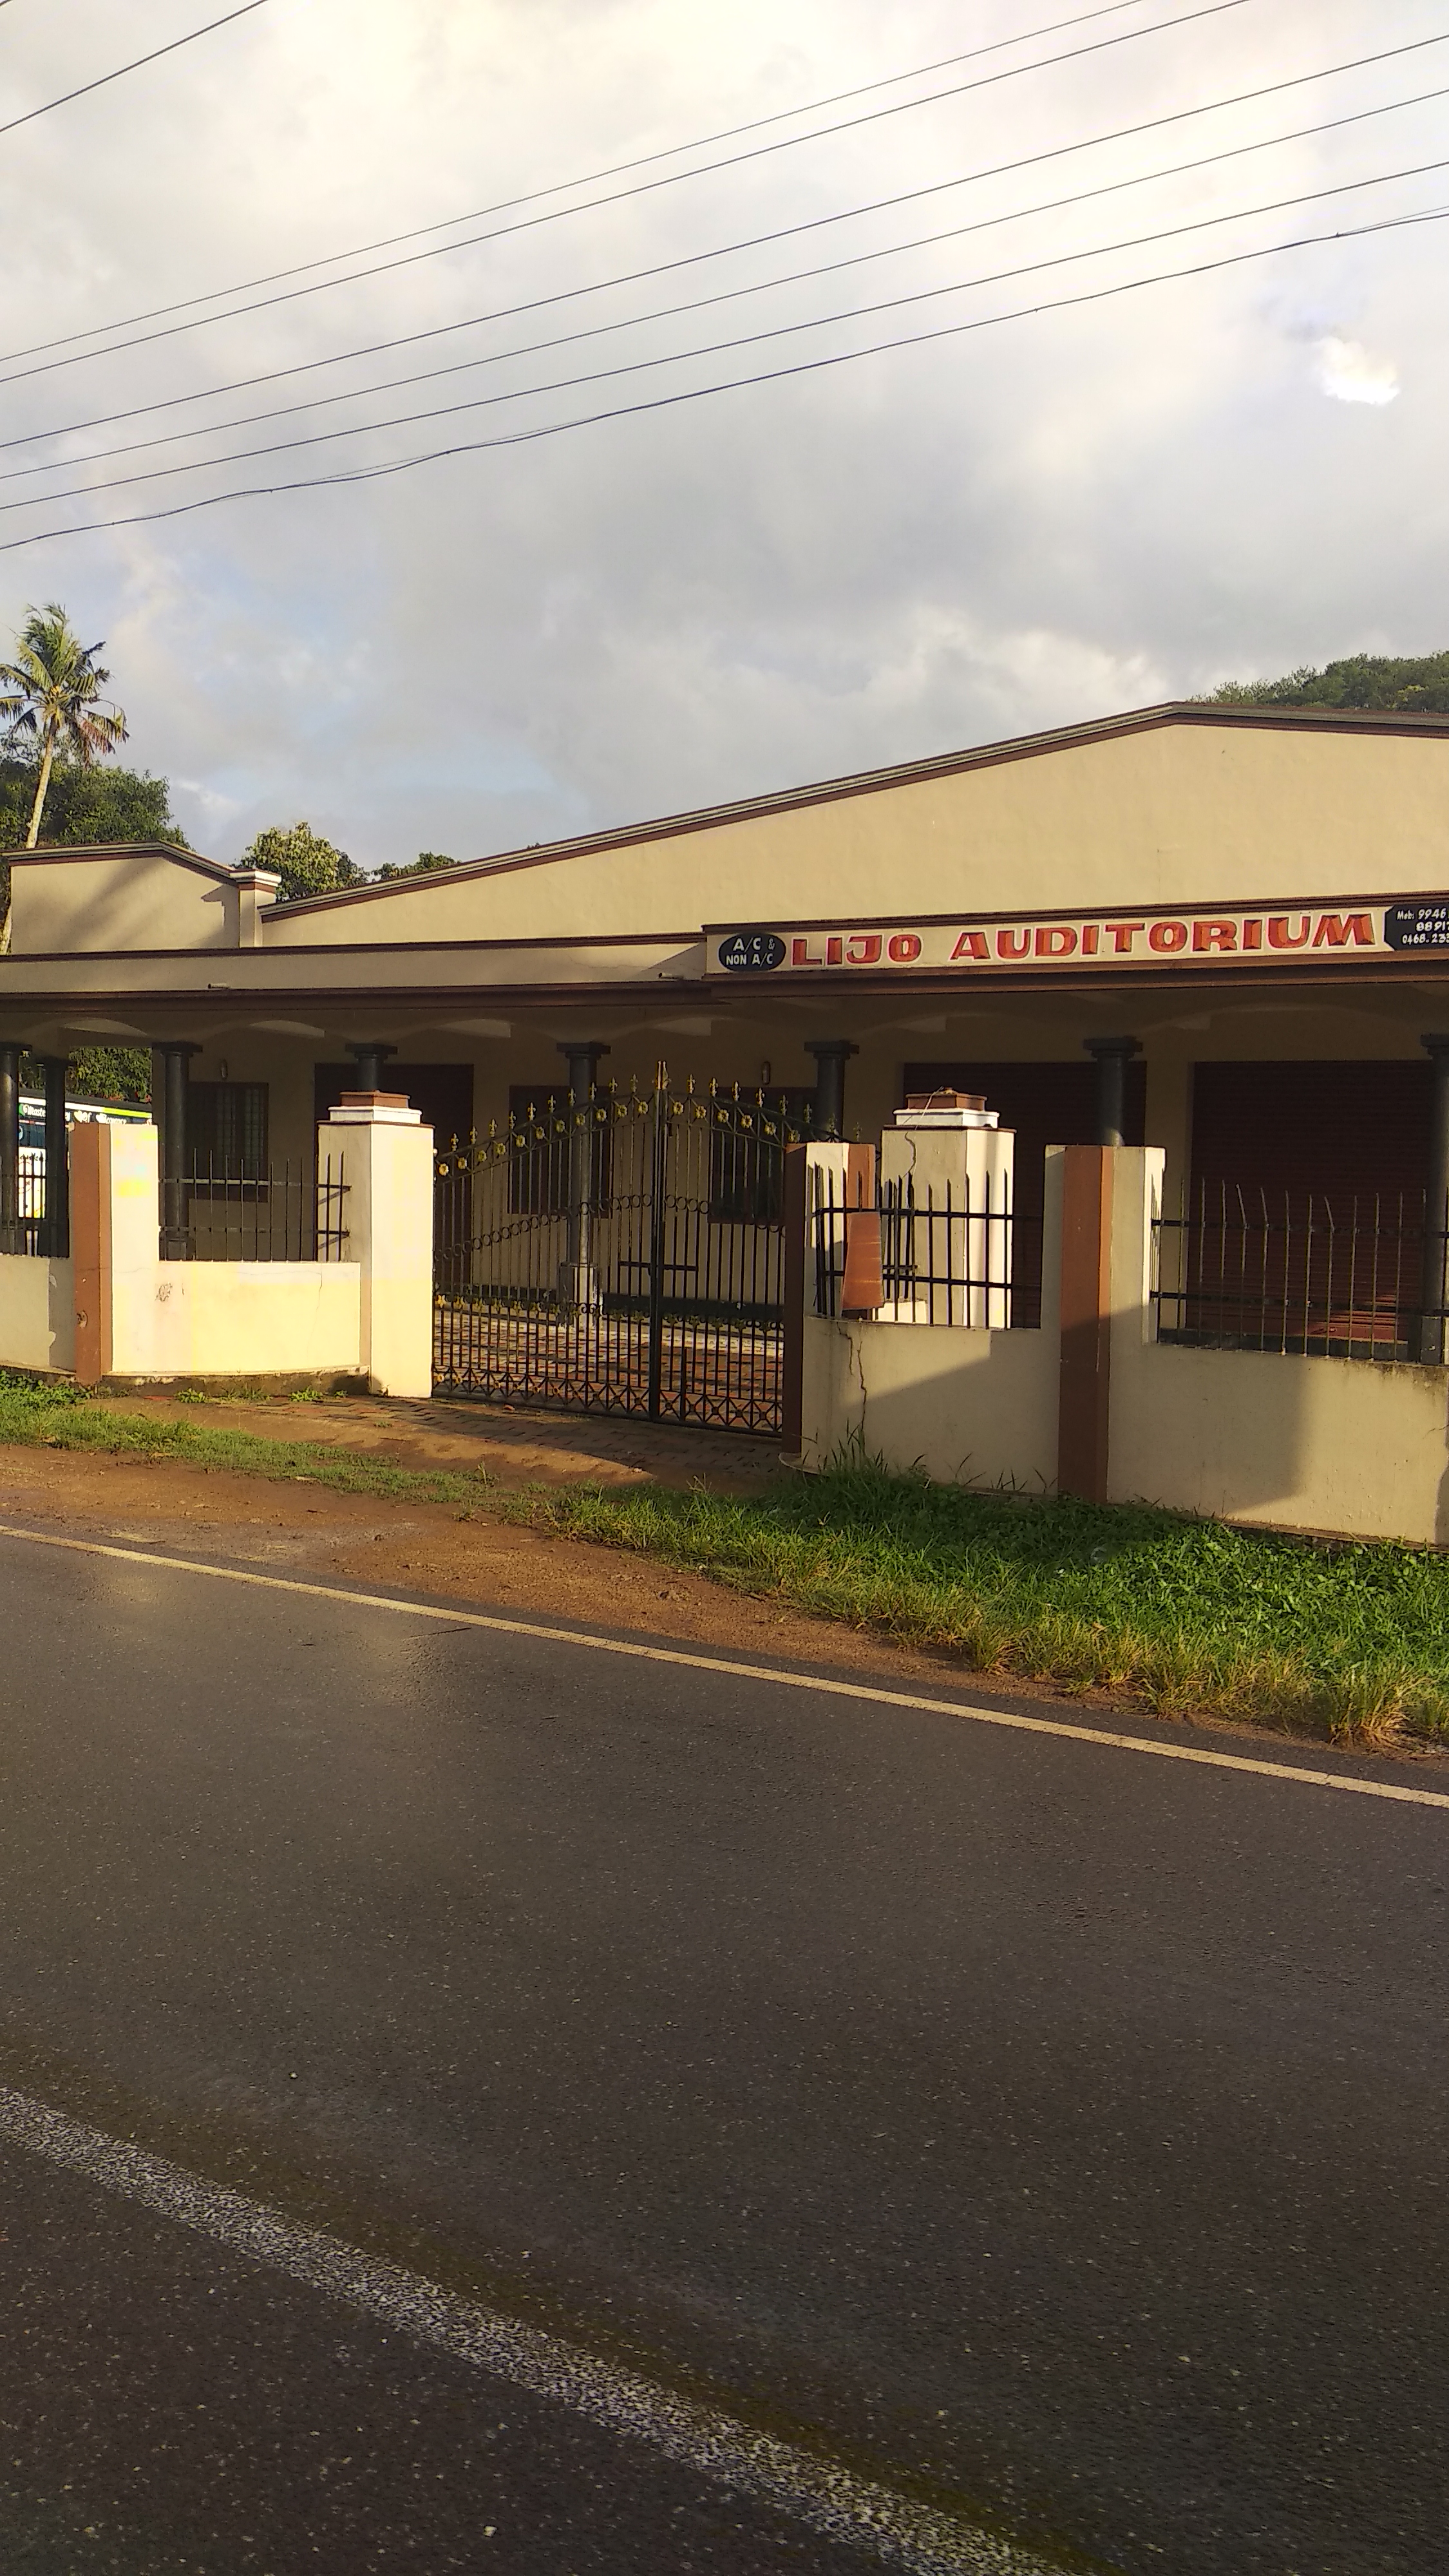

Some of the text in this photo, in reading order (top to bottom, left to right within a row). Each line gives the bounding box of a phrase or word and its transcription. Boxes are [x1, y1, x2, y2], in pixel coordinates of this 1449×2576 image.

[1418, 908, 1449, 920] 9946
[733, 937, 775, 953] A/C &
[791, 913, 1376, 966] LIJO AUDITORIUM
[726, 953, 773, 967] NON A/C
